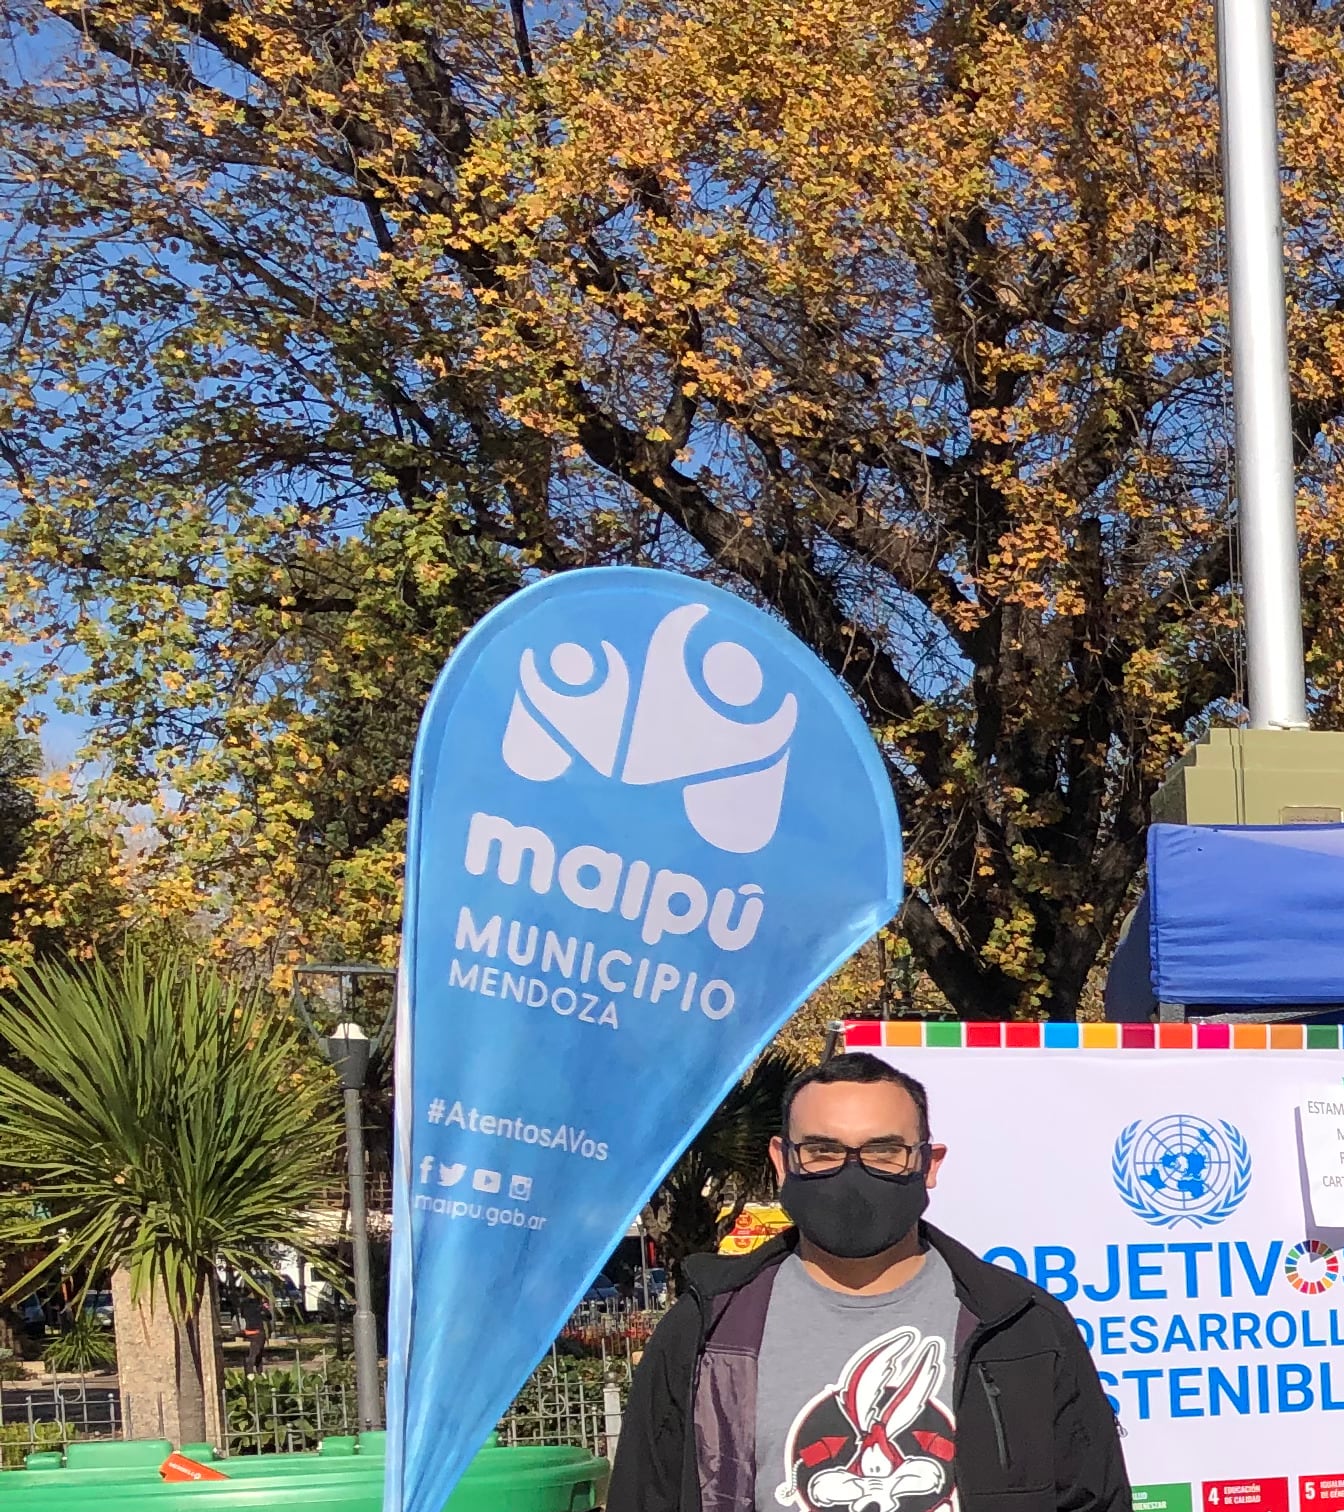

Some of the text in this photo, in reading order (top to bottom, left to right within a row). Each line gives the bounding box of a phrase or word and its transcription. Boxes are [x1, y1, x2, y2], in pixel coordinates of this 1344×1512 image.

[455, 907, 735, 1021] MUNICIPIO
[448, 959, 620, 1030] MENDOZA
[427, 1098, 610, 1162] #AtentosAVos
[414, 1193, 548, 1231] maipu.gob.ar
[1208, 1487, 1220, 1506] 4
[1224, 1494, 1261, 1505] DE CALIDAD
[1304, 1481, 1316, 1500] 5
